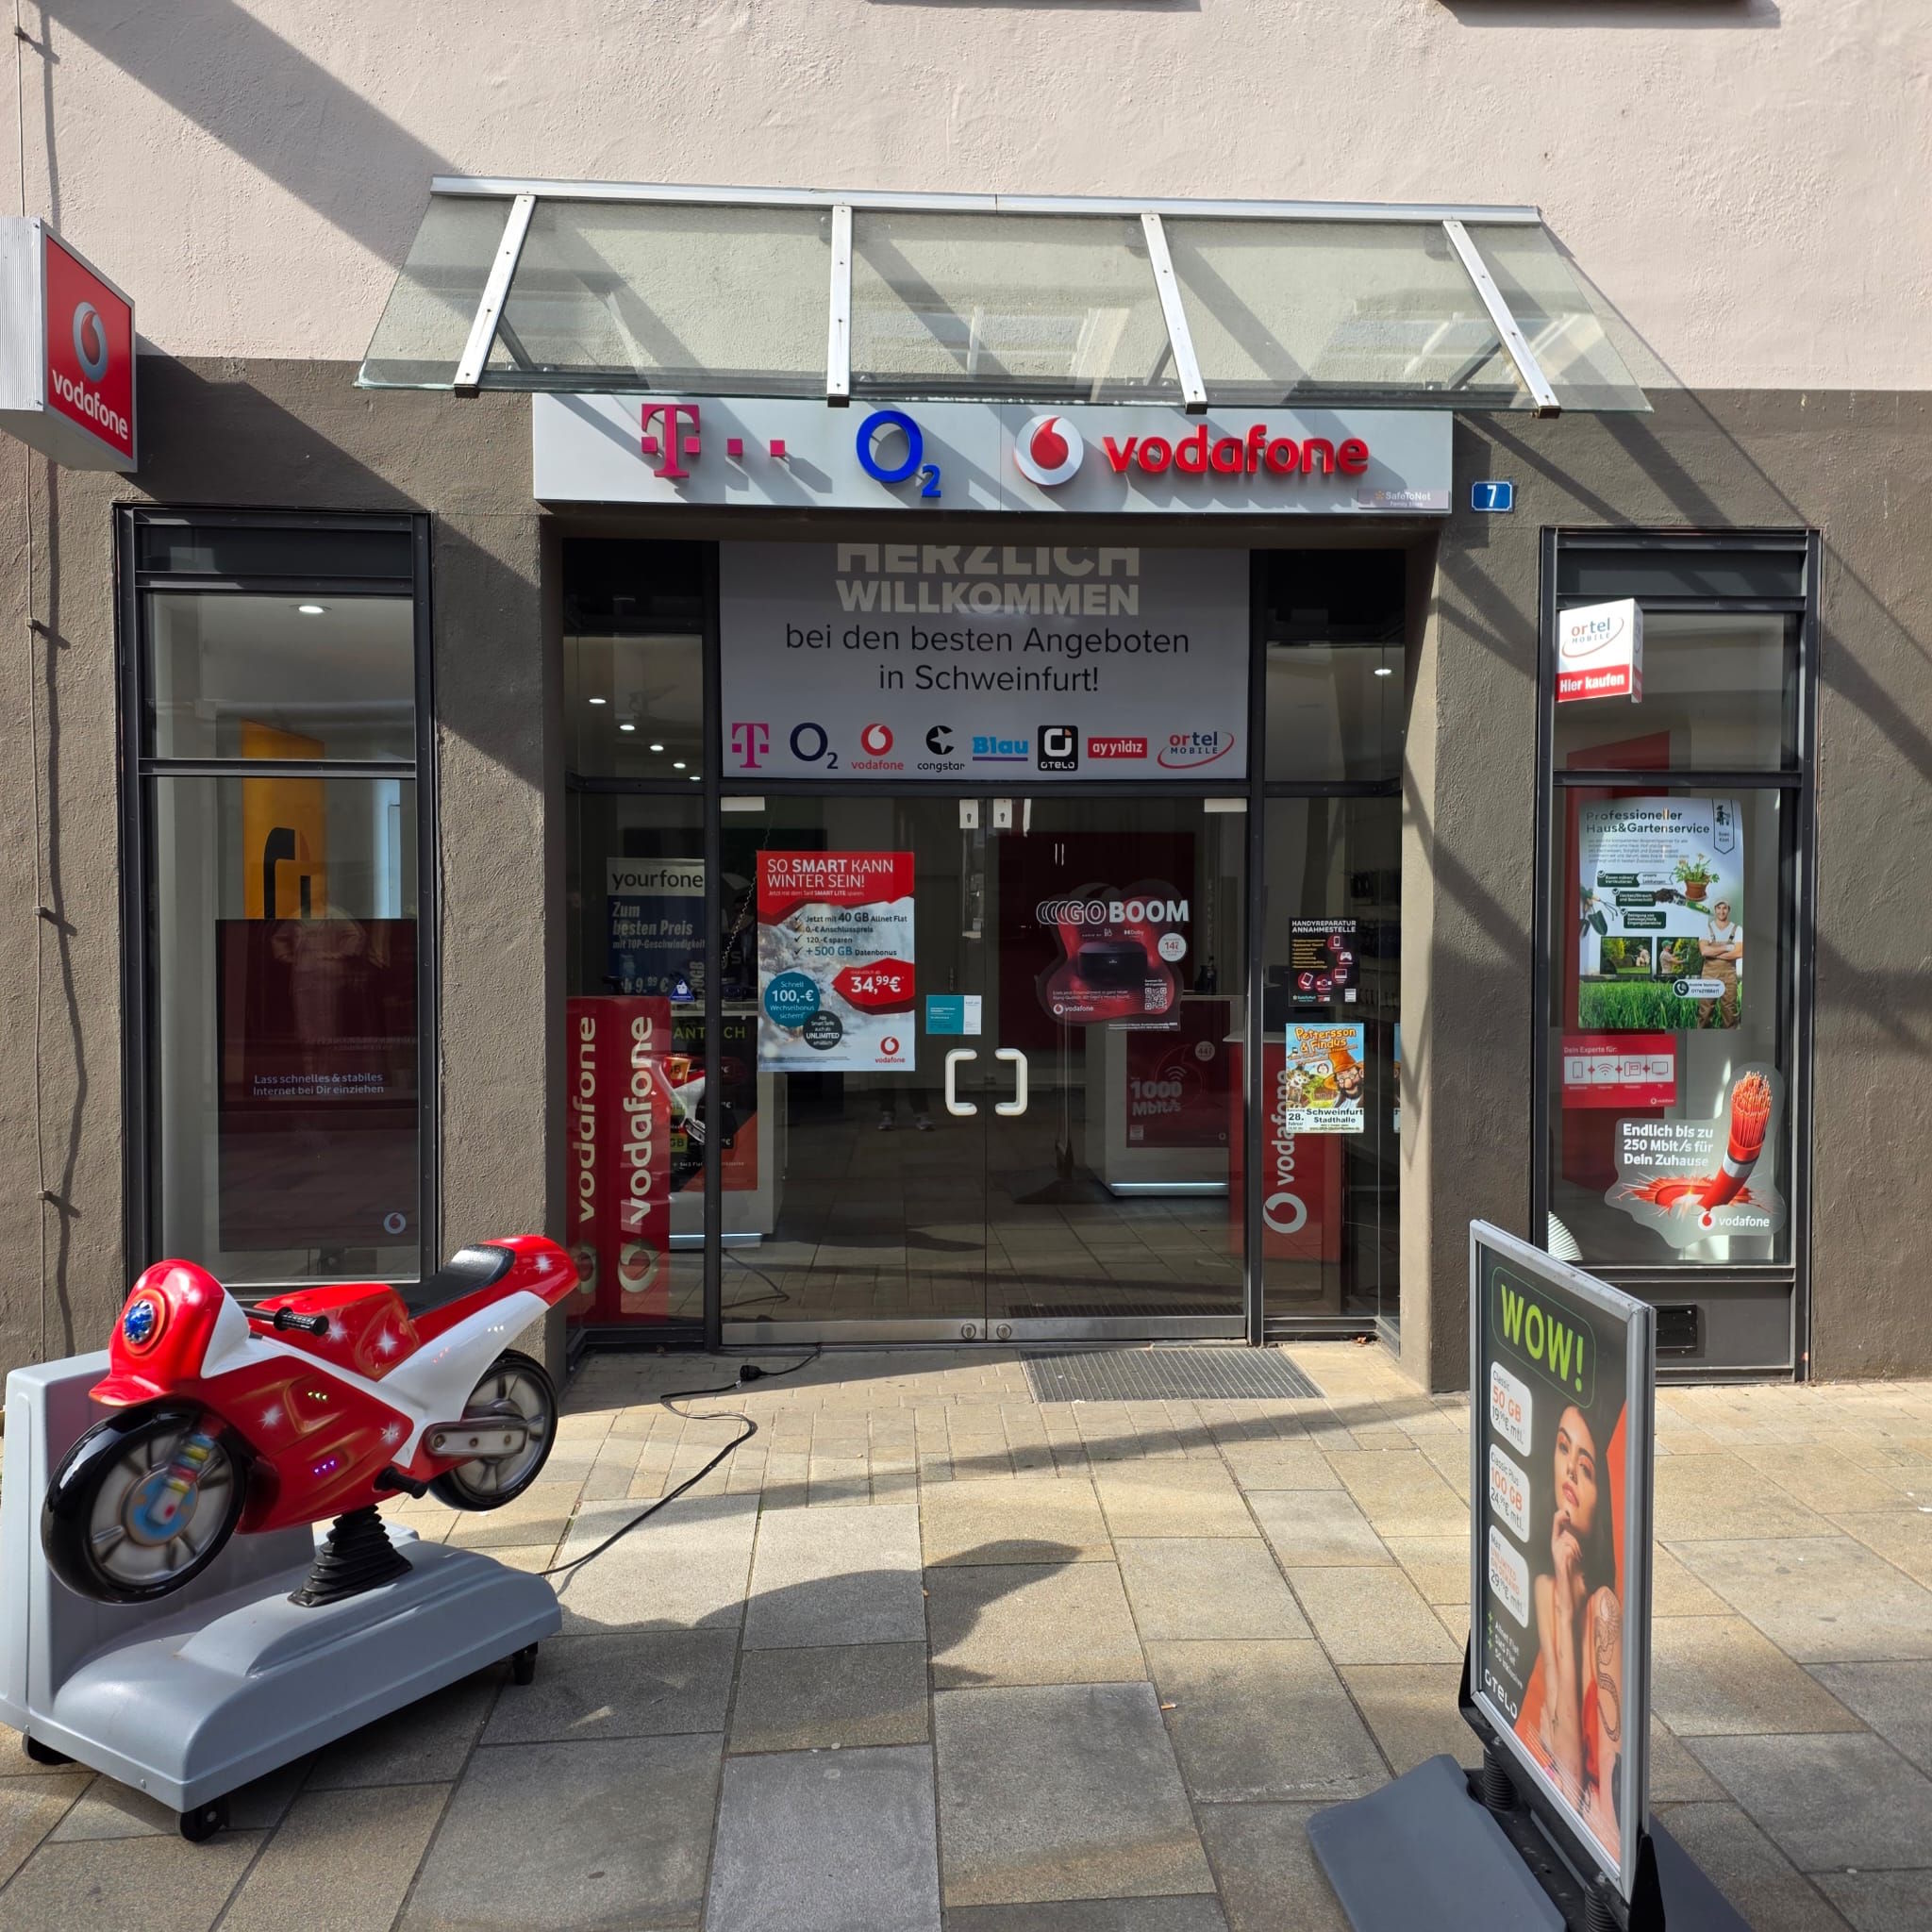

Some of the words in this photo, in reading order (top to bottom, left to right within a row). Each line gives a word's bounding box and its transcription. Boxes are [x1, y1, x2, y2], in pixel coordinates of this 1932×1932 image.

[52, 370, 128, 440] vodafone
[1102, 424, 1370, 474] vodafone
[1487, 485, 1497, 508] 7
[837, 542, 1140, 576] HERZLICH
[836, 579, 1140, 615] WILLKOMMEN
[1571, 617, 1610, 637] ortel
[786, 625, 831, 649] bei
[842, 625, 900, 650] den
[911, 625, 1013, 651] besten
[1023, 626, 1190, 658] Angeboten
[879, 664, 904, 690] in
[914, 664, 1099, 691] Schweinfurt!
[1559, 680, 1583, 693] Hier
[1585, 673, 1624, 690] kaufen
[973, 736, 1029, 754] Blau
[1169, 731, 1218, 746] ortel
[1092, 743, 1108, 755] ay
[851, 759, 905, 771] vodafone
[917, 761, 965, 773] congstar
[1586, 808, 1683, 821] Professioneller
[1586, 823, 1710, 834] Haus&Gartenservice
[767, 859, 788, 873] SO
[792, 859, 847, 873] SMART
[852, 859, 893, 873] KANN
[612, 870, 704, 890] yourfone
[767, 874, 824, 888] WINTER
[828, 874, 865, 888] SEIN!
[612, 902, 641, 918] Zum
[838, 912, 852, 923] 40
[854, 912, 869, 923] GB
[612, 918, 658, 936] besten
[660, 920, 693, 936] Preis
[821, 925, 874, 935] Anschlusspreis
[814, 946, 835, 956] 500
[838, 946, 853, 956] GB
[1294, 1025, 1357, 1041] Pettersson
[1308, 1038, 1347, 1052] Findus
[255, 1074, 277, 1084] Lass
[280, 1074, 330, 1084] schnelles
[331, 1073, 341, 1083] &
[342, 1073, 383, 1083] stabiles
[253, 1087, 295, 1096] Internet
[298, 1086, 314, 1095] bei
[316, 1086, 330, 1095] Dir
[333, 1085, 384, 1094] einziehen
[1130, 1080, 1183, 1100] 1000
[573, 1016, 596, 1224] vodafone
[624, 1016, 653, 1224] vodafone
[1306, 1108, 1363, 1116] Schweinfurt
[1623, 1123, 1673, 1137] Endlich
[1675, 1124, 1694, 1138] bis
[1697, 1128, 1713, 1139] zu
[1624, 1139, 1648, 1152] 250
[1651, 1140, 1691, 1153] Mbit/s
[1694, 1141, 1713, 1153] für
[1624, 1153, 1653, 1166] Dein
[1656, 1154, 1709, 1167] Zuhause
[1719, 1215, 1770, 1227] vodafone
[1501, 1283, 1584, 1392] WOW!
[1492, 1386, 1506, 1408] 50
[1508, 1399, 1522, 1423] GB
[1491, 1466, 1507, 1495] 100
[1509, 1487, 1523, 1511] GB
